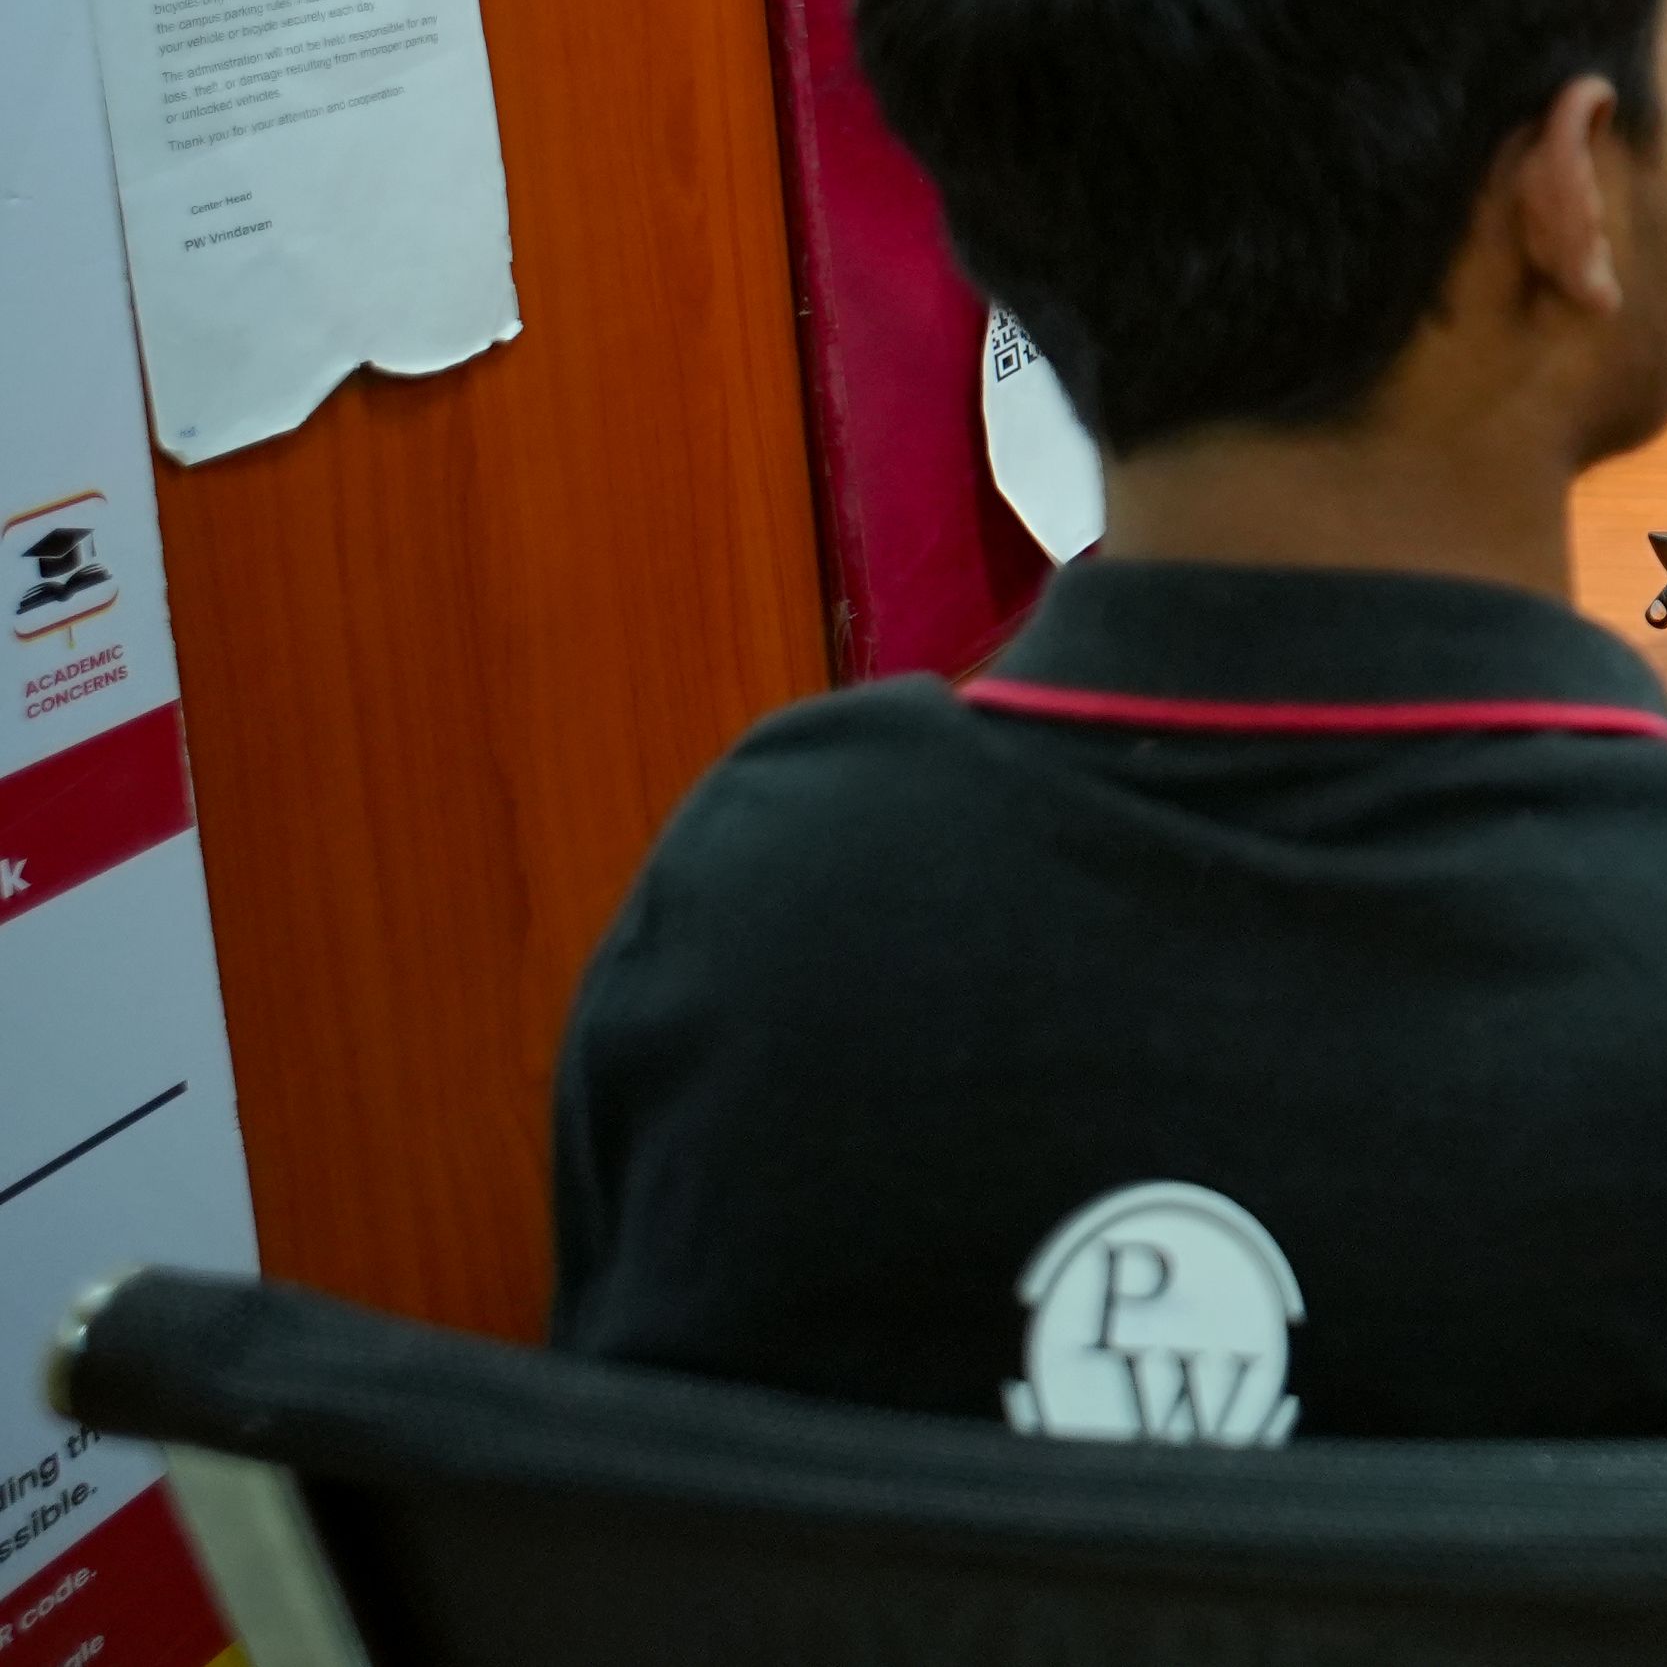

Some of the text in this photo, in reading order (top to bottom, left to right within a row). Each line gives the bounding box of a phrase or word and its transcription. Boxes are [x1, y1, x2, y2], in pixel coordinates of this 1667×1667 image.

[156, 20, 176, 34] the
[178, 14, 221, 32] campus
[224, 2, 264, 22] parking
[168, 133, 204, 151] Thank
[190, 196, 223, 215] Center
[184, 236, 206, 252] PW
[24, 644, 124, 698] ACADEMIC
[25, 665, 129, 721] CONCERNS
[1087, 1241, 1266, 1438] PW
